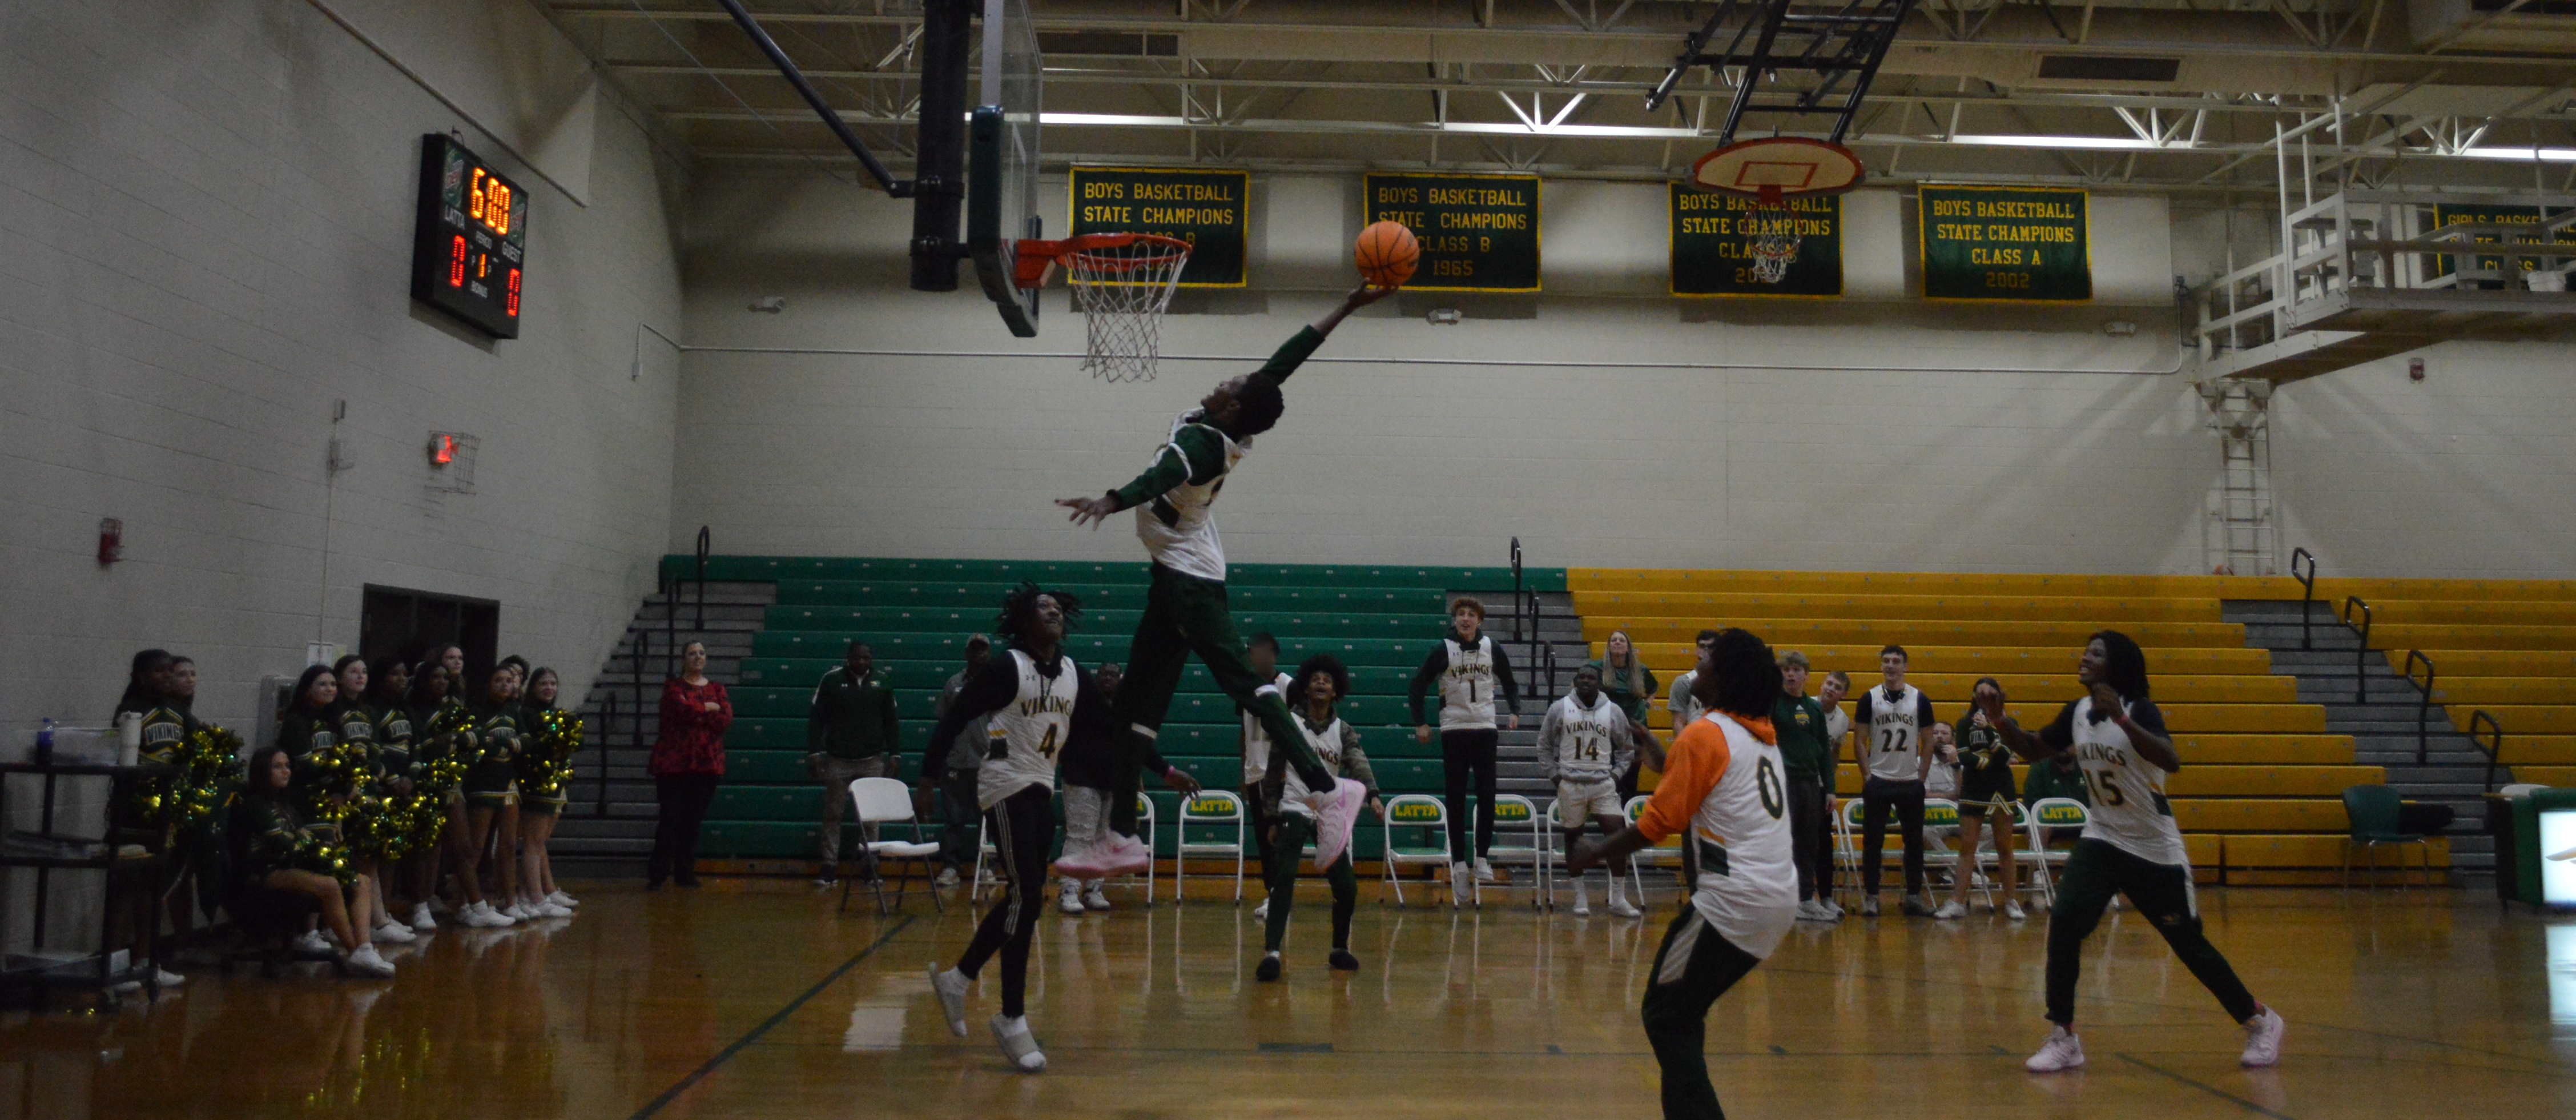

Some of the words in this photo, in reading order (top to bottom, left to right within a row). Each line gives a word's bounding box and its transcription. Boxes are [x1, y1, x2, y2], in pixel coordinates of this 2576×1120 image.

[1085, 182, 1124, 199] BOYS
[1134, 183, 1233, 201] BASKETBALL
[1379, 187, 1418, 203] BOYS
[1428, 188, 1527, 206] BASKETBALL
[1679, 194, 1720, 211] BOYS
[1934, 200, 1970, 216] BOYS
[1977, 202, 2075, 219] BASKETBALL
[445, 204, 465, 230] LATTA
[1085, 206, 1132, 223] STATE
[1142, 207, 1233, 225] CHAMPIONS
[1440, 212, 1527, 230] CHAMPIONS
[1683, 218, 1730, 234] STATE
[1737, 219, 1830, 236] CHAMPIONS
[1937, 223, 1982, 240] STATE
[1989, 224, 2075, 242] CHAMPIONS
[450, 235, 466, 287] 0
[1972, 248, 2022, 265] CLASS
[2031, 250, 2041, 266] A
[1433, 260, 1474, 277] 1965
[1986, 272, 2030, 289] 2002
[507, 268, 521, 317] 0
[1451, 663, 1489, 678] VIKINGS
[1467, 679, 1476, 702] 1
[1021, 695, 1072, 717] VIKING
[1566, 721, 1607, 737] VIKINGS
[1875, 713, 1913, 726] VIKINGS
[1038, 722, 1057, 759] 4
[1575, 737, 1599, 761] 14
[1882, 729, 1907, 753] 22
[1757, 756, 1783, 819] 0
[2083, 769, 2123, 806] 15
[1191, 800, 1233, 812] LATTA
[1395, 805, 1438, 817] LATTA
[2040, 806, 2083, 819] LATTA
